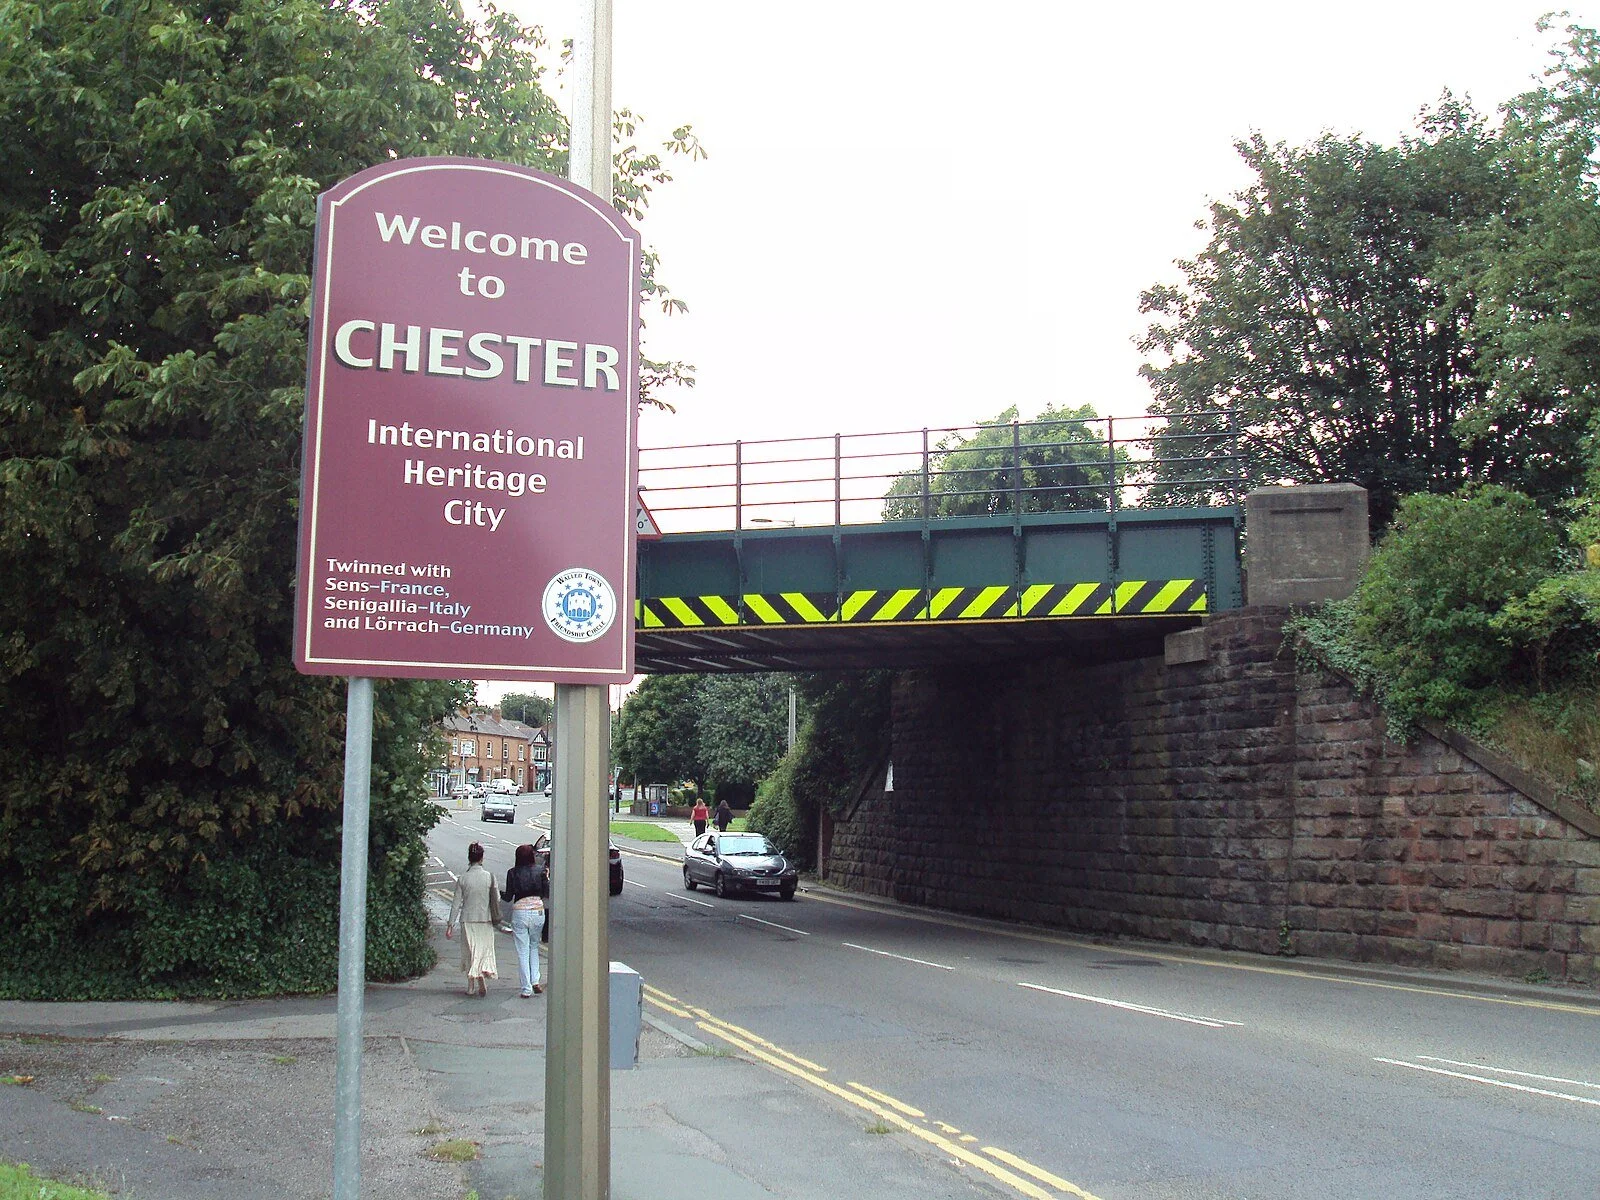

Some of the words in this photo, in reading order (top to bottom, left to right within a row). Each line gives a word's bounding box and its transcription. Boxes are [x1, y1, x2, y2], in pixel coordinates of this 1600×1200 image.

[375, 212, 588, 265] Welcome
[457, 266, 506, 299] to
[334, 319, 621, 391] CHESTER
[367, 419, 584, 460] International
[403, 459, 547, 497] Heritage
[443, 499, 506, 532] City
[326, 558, 406, 576] Twinned
[410, 563, 451, 578] with
[324, 596, 472, 618] Senigallia-Italy
[324, 616, 360, 630] and
